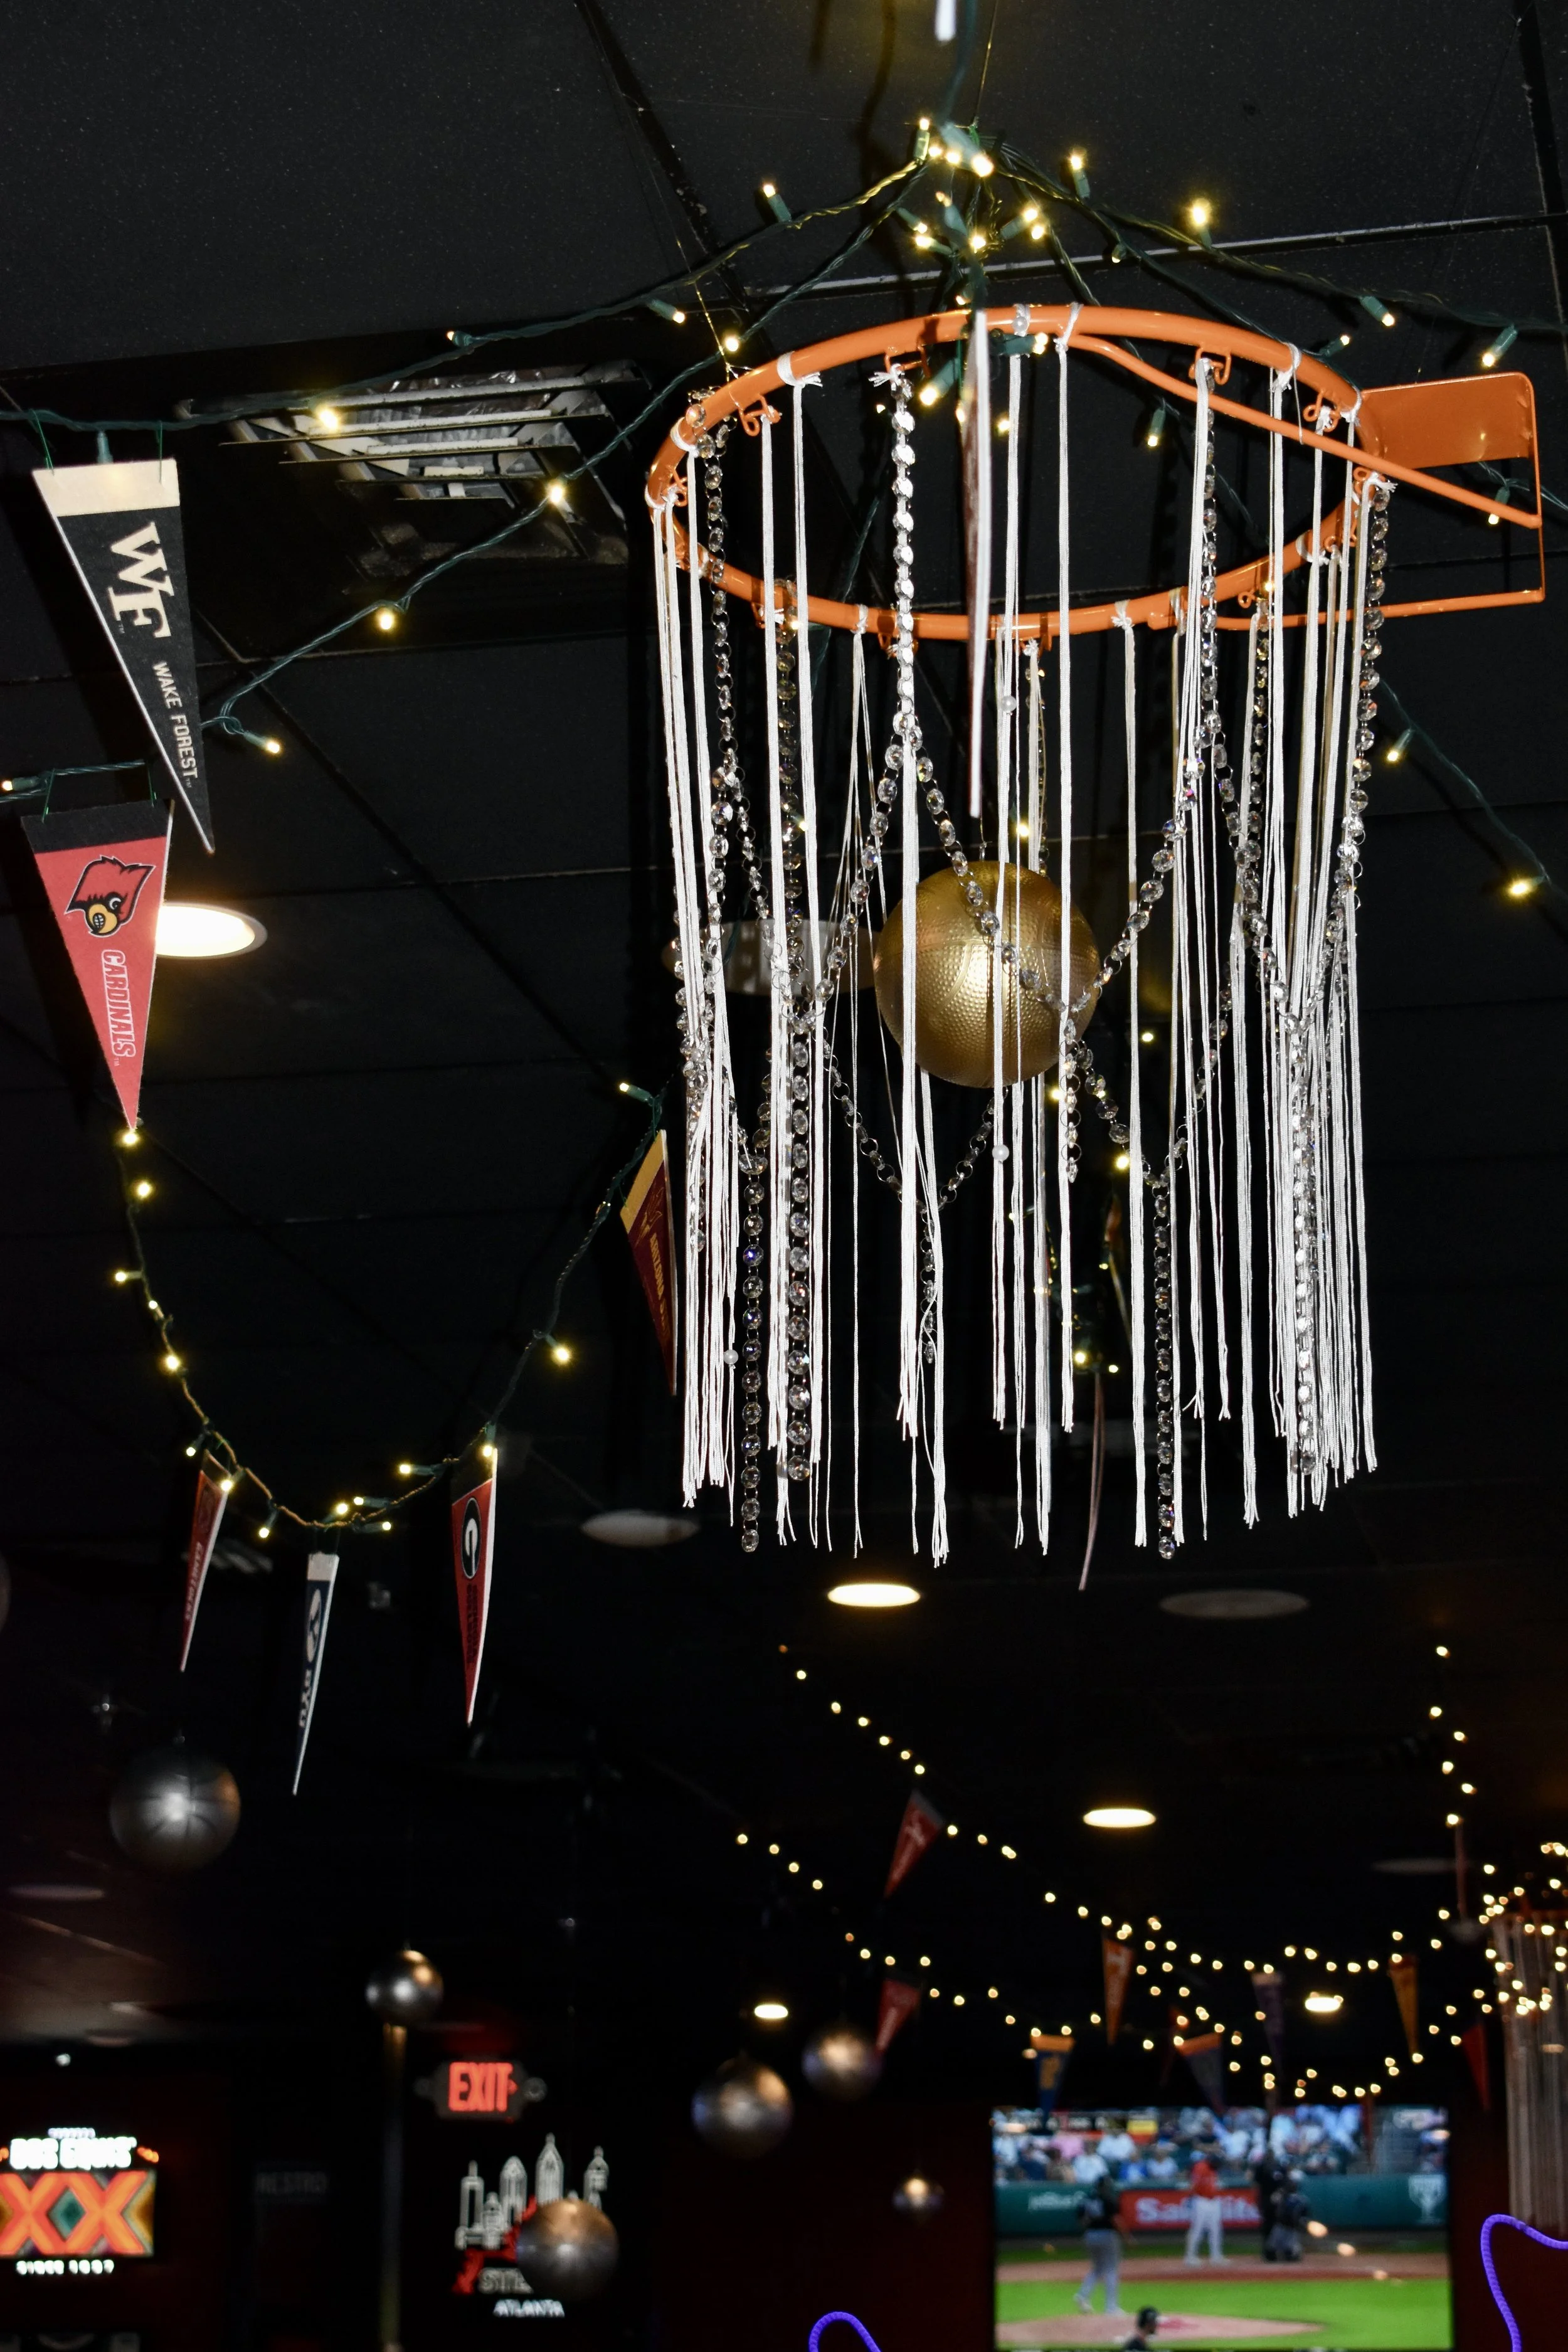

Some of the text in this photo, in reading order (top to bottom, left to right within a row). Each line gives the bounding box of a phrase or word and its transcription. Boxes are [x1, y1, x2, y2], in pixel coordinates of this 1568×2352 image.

[152, 660, 198, 780] WAKE FOREST
[101, 948, 136, 1059] CARDINALS
[650, 1232, 665, 1301] ARIZONA
[448, 2061, 514, 2112] EXIT
[493, 2299, 565, 2318] ATLANTA
